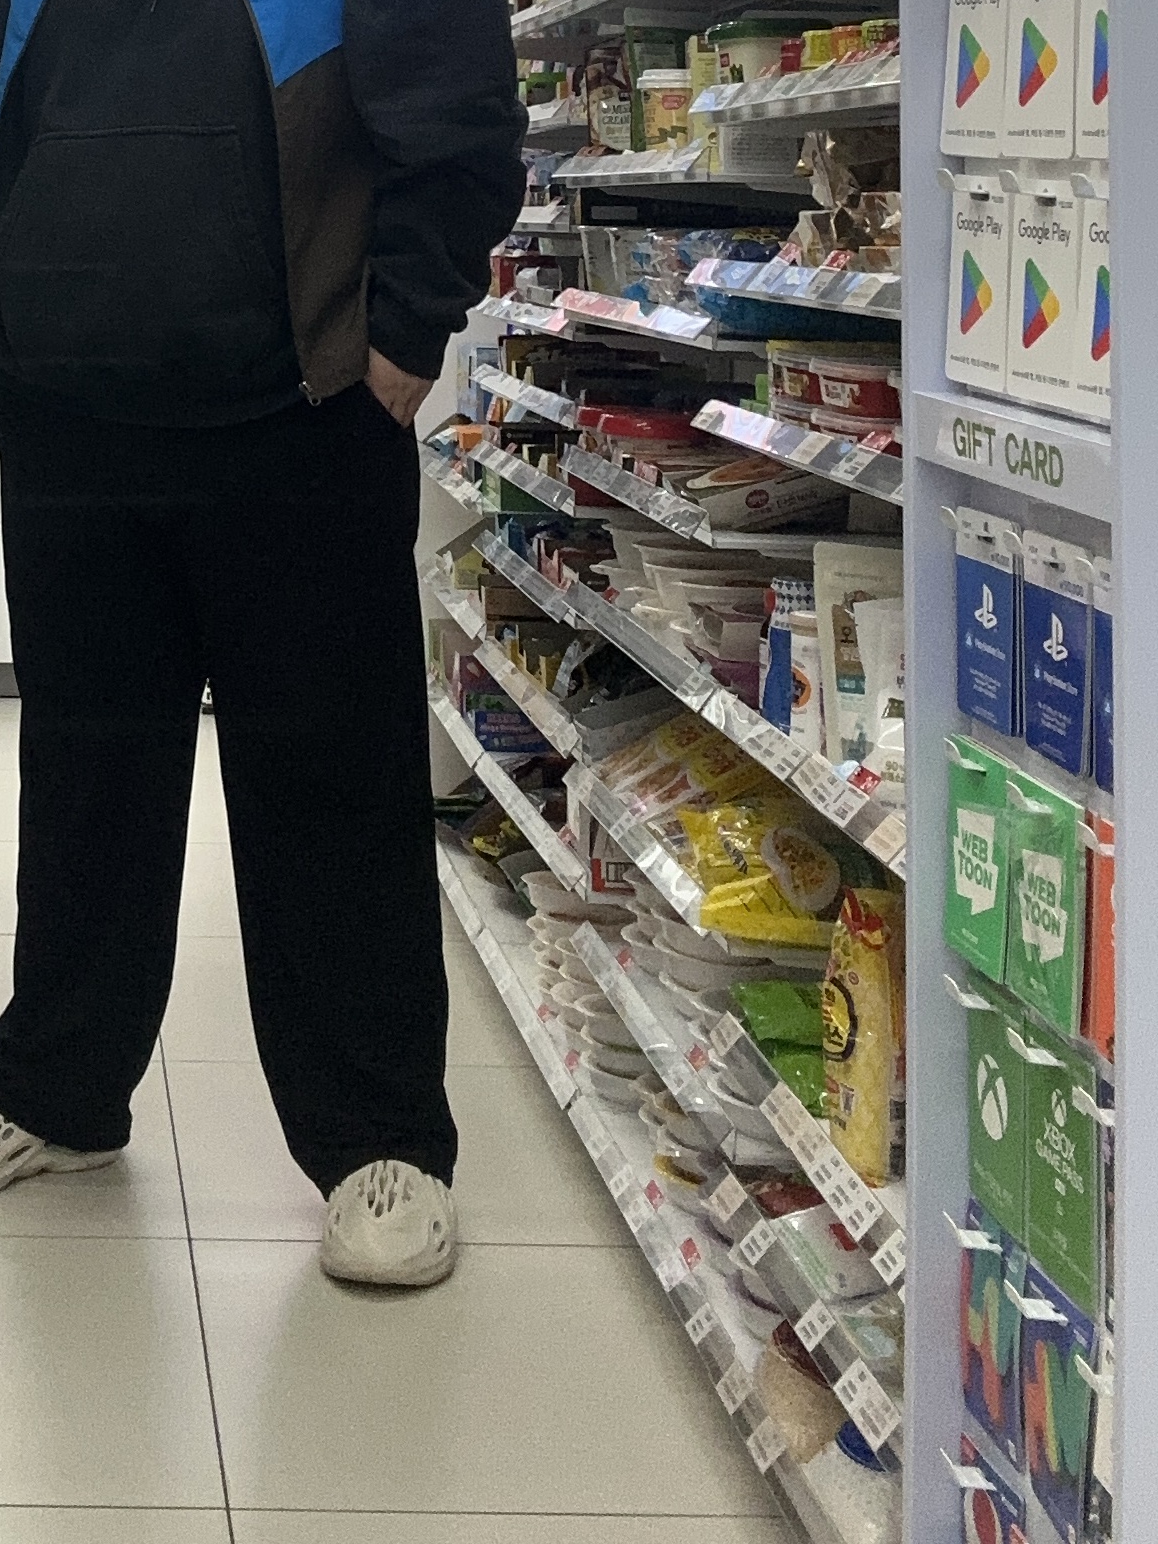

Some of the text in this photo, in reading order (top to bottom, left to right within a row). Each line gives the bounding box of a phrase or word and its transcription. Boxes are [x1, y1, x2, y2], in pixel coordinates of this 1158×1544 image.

[956, 211, 1003, 239] Google Play
[1018, 218, 1071, 247] Google Play
[952, 417, 1065, 488] GIFT CARD
[960, 829, 988, 864] WEB
[958, 849, 993, 891] TOON
[1027, 871, 1056, 908] WEB
[1023, 893, 1061, 938] TOON
[1043, 1117, 1077, 1167] XBOX
[1062, 1161, 1085, 1194] PASS
